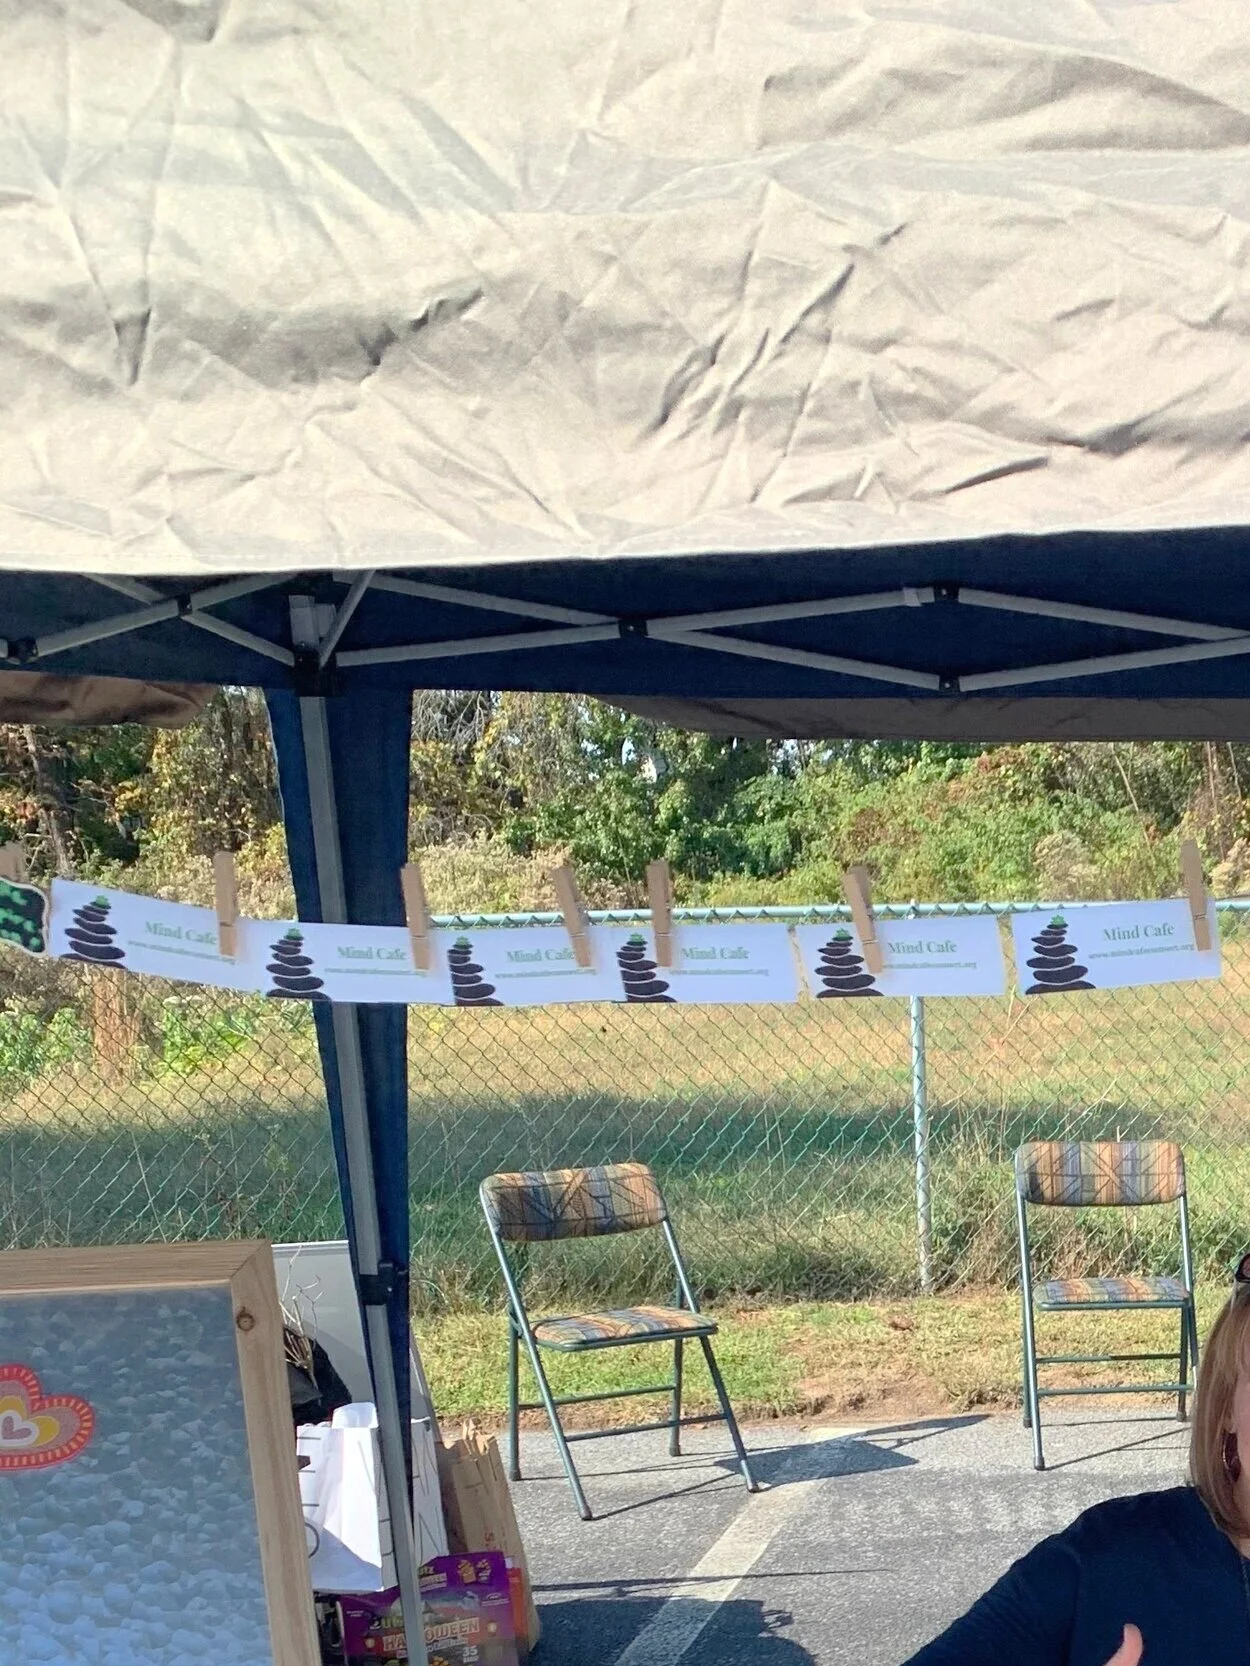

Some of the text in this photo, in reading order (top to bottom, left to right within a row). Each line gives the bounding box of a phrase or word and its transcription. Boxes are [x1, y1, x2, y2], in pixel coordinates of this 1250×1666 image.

[144, 921, 217, 945] Mind Cafe
[1103, 923, 1174, 941] Mind Cafe
[337, 946, 406, 961] Mind Cafe
[506, 947, 575, 962] Mind Cafe
[681, 946, 749, 960] Mind Cafe
[888, 941, 957, 954] Mind Cafe
[382, 1617, 479, 1652] HAOWEEN
